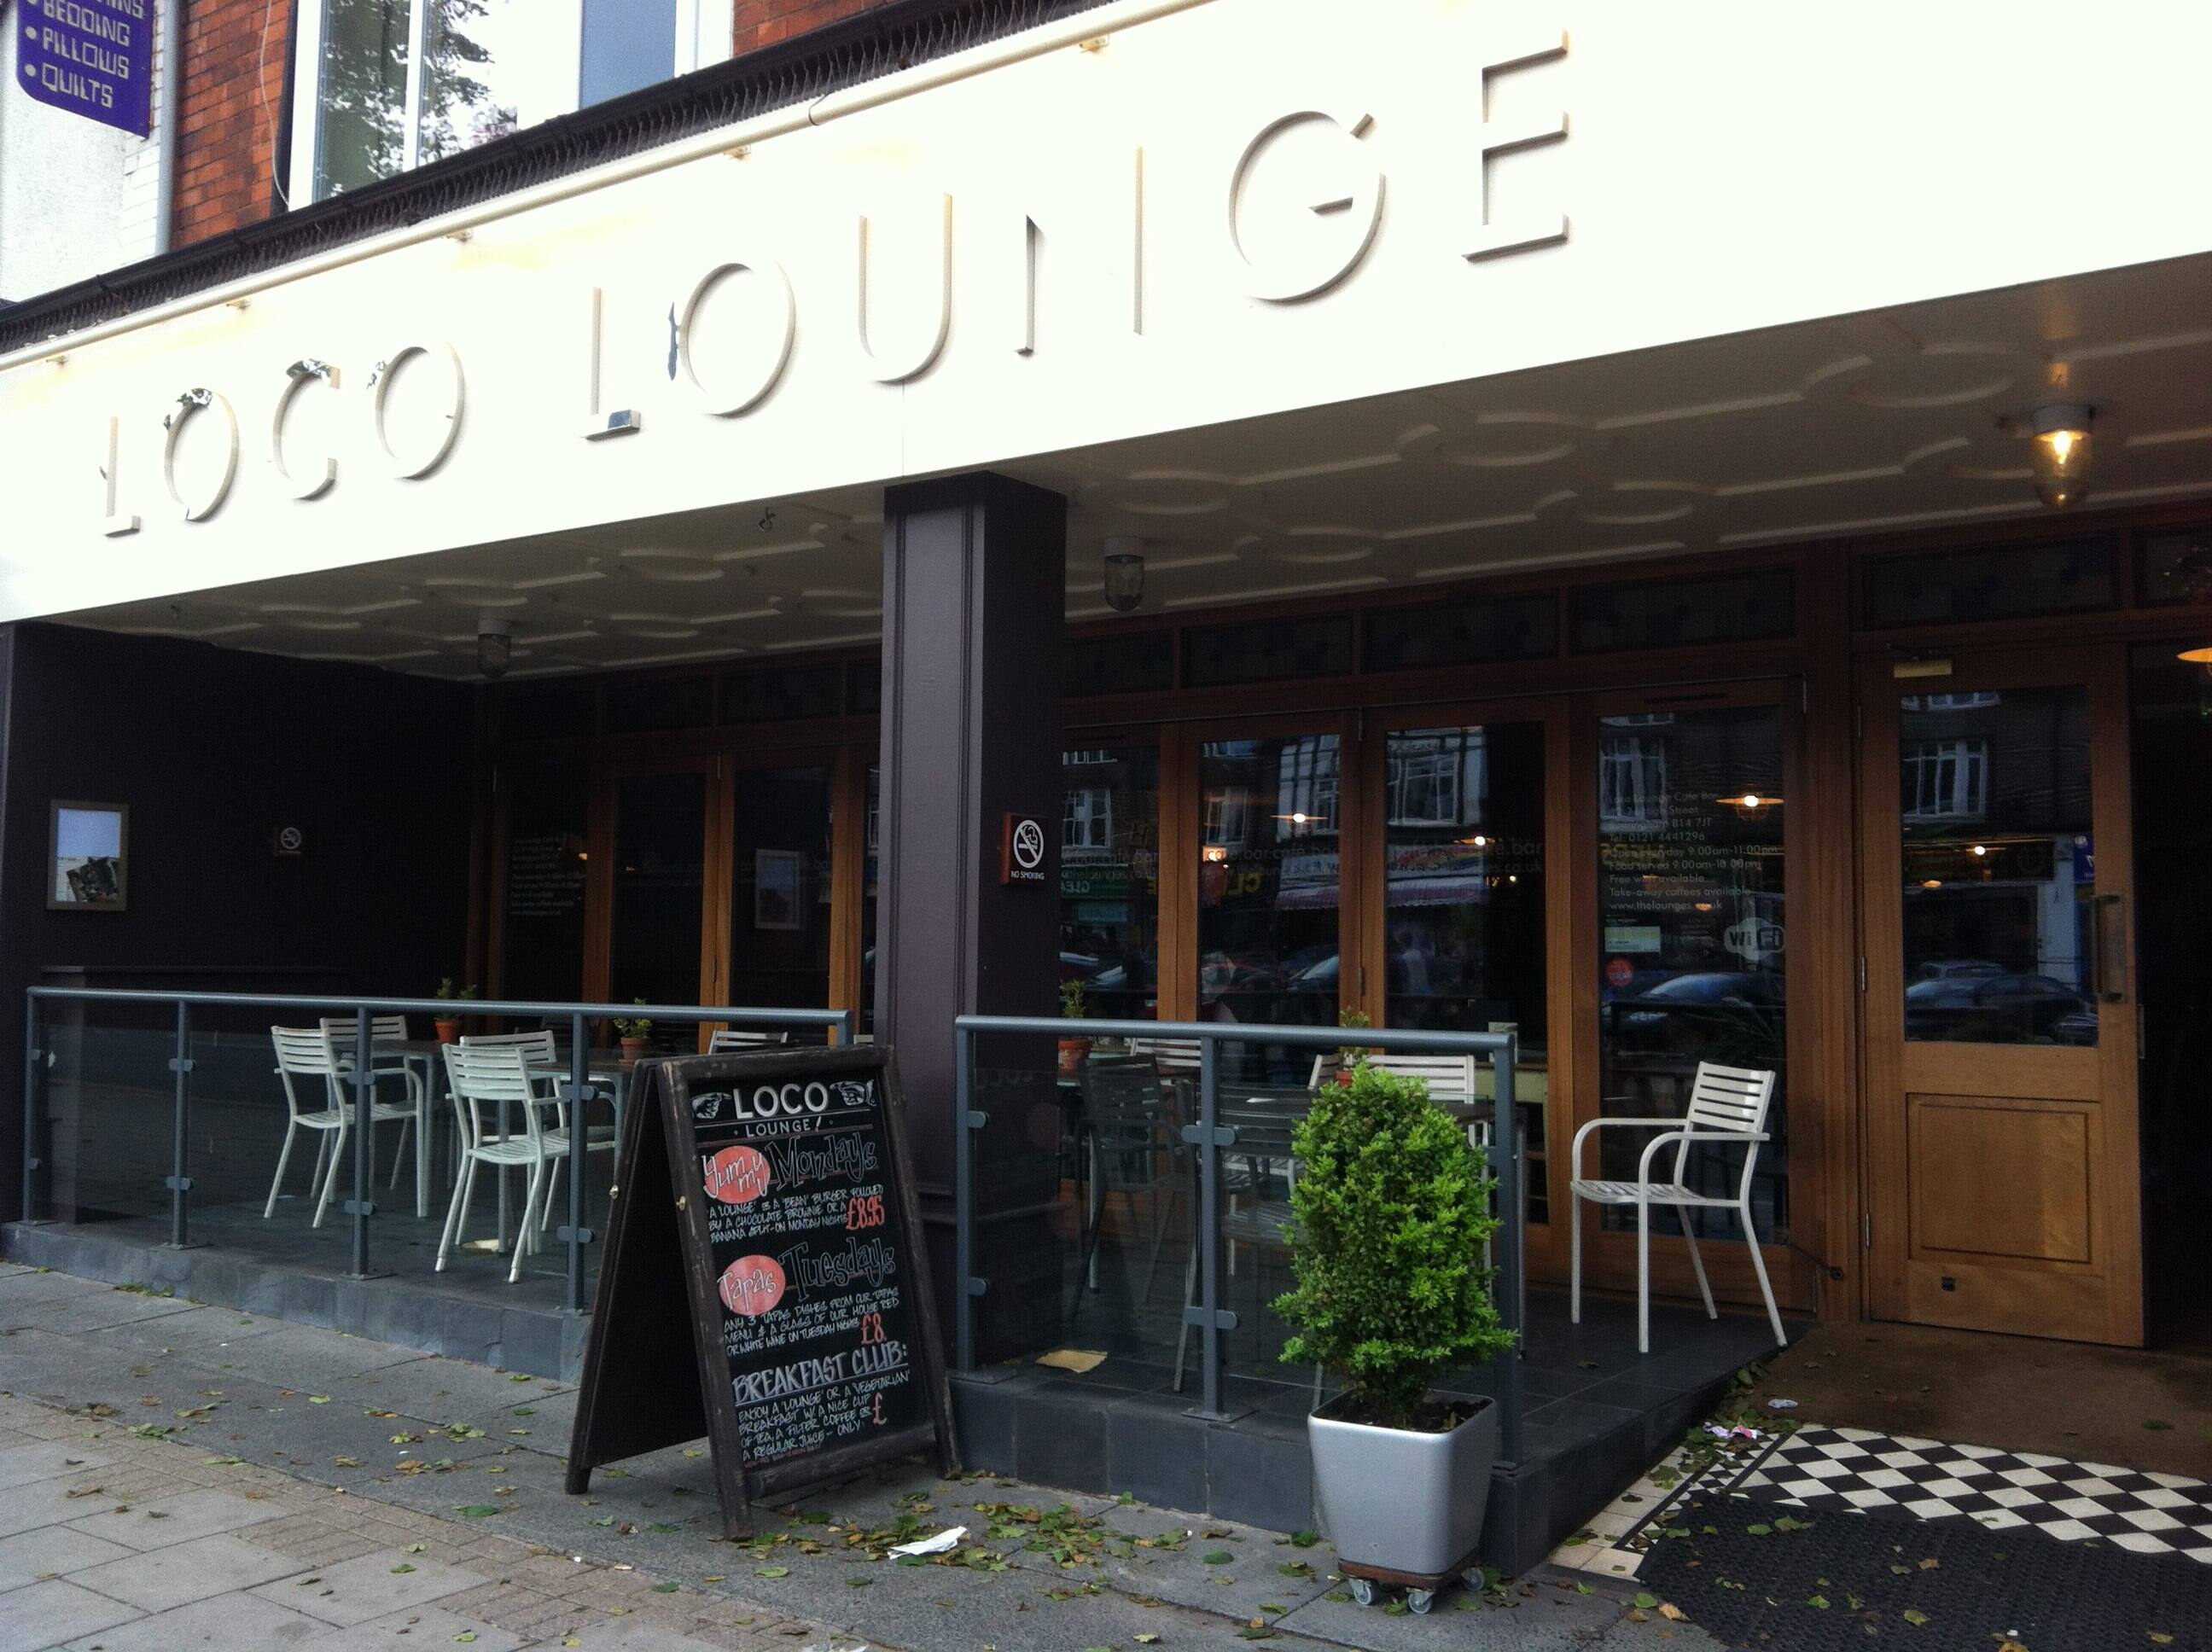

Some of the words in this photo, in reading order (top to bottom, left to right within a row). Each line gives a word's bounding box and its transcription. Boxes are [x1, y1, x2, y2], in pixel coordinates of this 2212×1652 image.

[43, 0, 131, 47] BEDDING
[43, 26, 130, 79] PILLOWS
[42, 62, 114, 108] QUILTS
[98, 340, 466, 539] LOCO
[582, 29, 1570, 442] LOUNGE
[733, 1082, 829, 1120] LOCO
[765, 1132, 879, 1192] Mondays
[735, 1210, 782, 1228] CHOCOLATE
[717, 1269, 777, 1311] Tapas
[778, 1237, 895, 1302] Tuesdays
[748, 1315, 756, 1326] 3
[770, 1323, 777, 1335] A
[879, 1297, 899, 1310] RED
[731, 1352, 847, 1404] BREAKFAST
[738, 1405, 769, 1423] ENJOY
[771, 1401, 780, 1415] A
[826, 1386, 841, 1400] OR
[845, 1385, 852, 1398] A
[738, 1408, 800, 1435] BREAKFAST
[818, 1405, 826, 1417] A
[827, 1399, 848, 1413] NICE
[775, 1428, 783, 1440] A
[785, 1417, 820, 1435] FILTER
[823, 1409, 856, 1426] COFFEE
[742, 1449, 751, 1462] A
[754, 1438, 799, 1460] REGULAR
